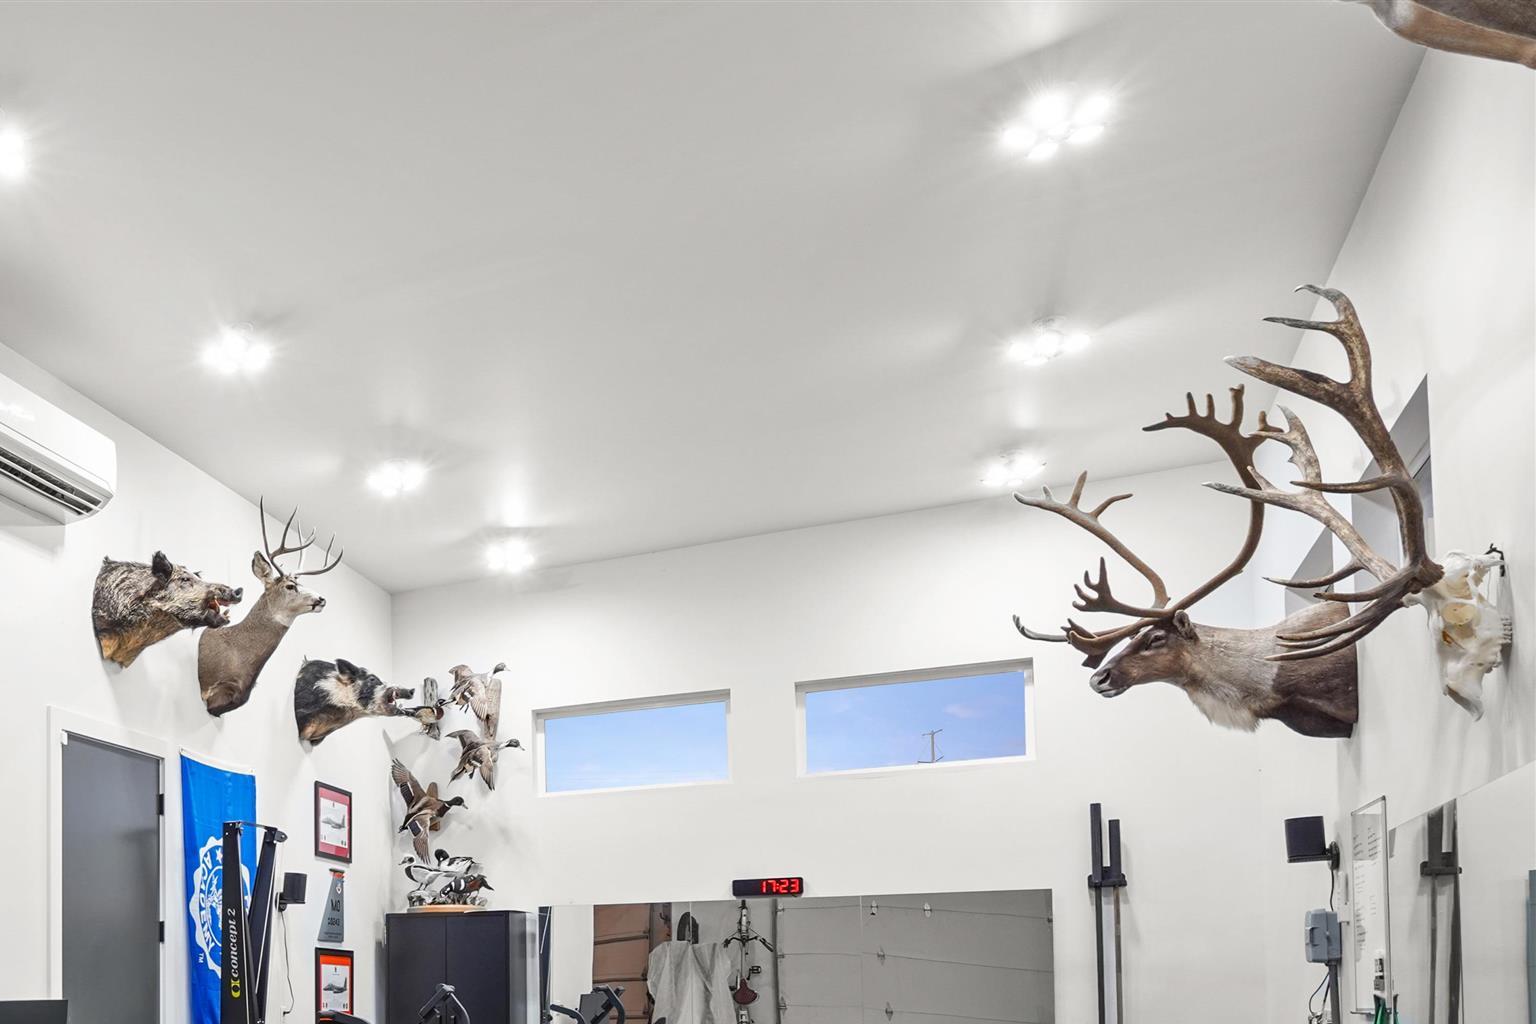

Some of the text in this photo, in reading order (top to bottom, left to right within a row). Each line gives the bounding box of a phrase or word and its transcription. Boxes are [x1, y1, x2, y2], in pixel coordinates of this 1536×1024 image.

[762, 878, 800, 894] 17:23
[227, 907, 239, 978] concept 2
